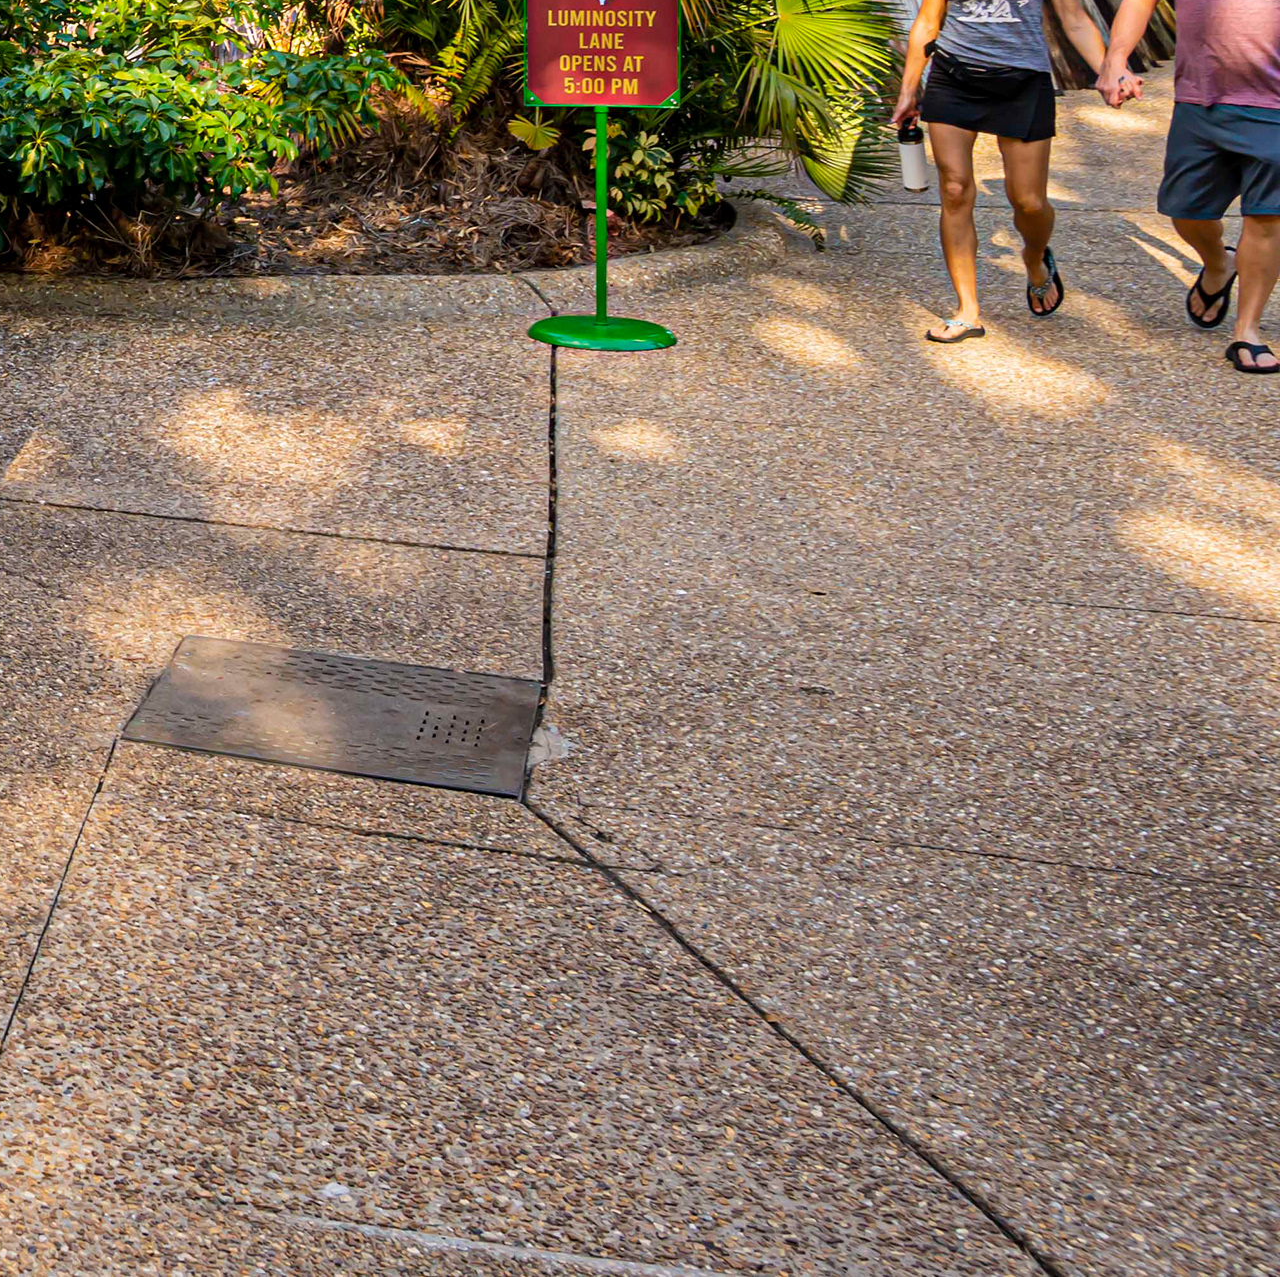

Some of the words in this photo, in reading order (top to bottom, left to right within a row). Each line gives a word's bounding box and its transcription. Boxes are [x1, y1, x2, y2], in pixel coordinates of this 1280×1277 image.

[547, 10, 657, 27] LUMINOSITY
[579, 33, 625, 49] LANE
[559, 55, 617, 72] OPENS
[623, 56, 644, 72] AT
[564, 77, 605, 94] 5:00
[611, 78, 638, 95] PM
